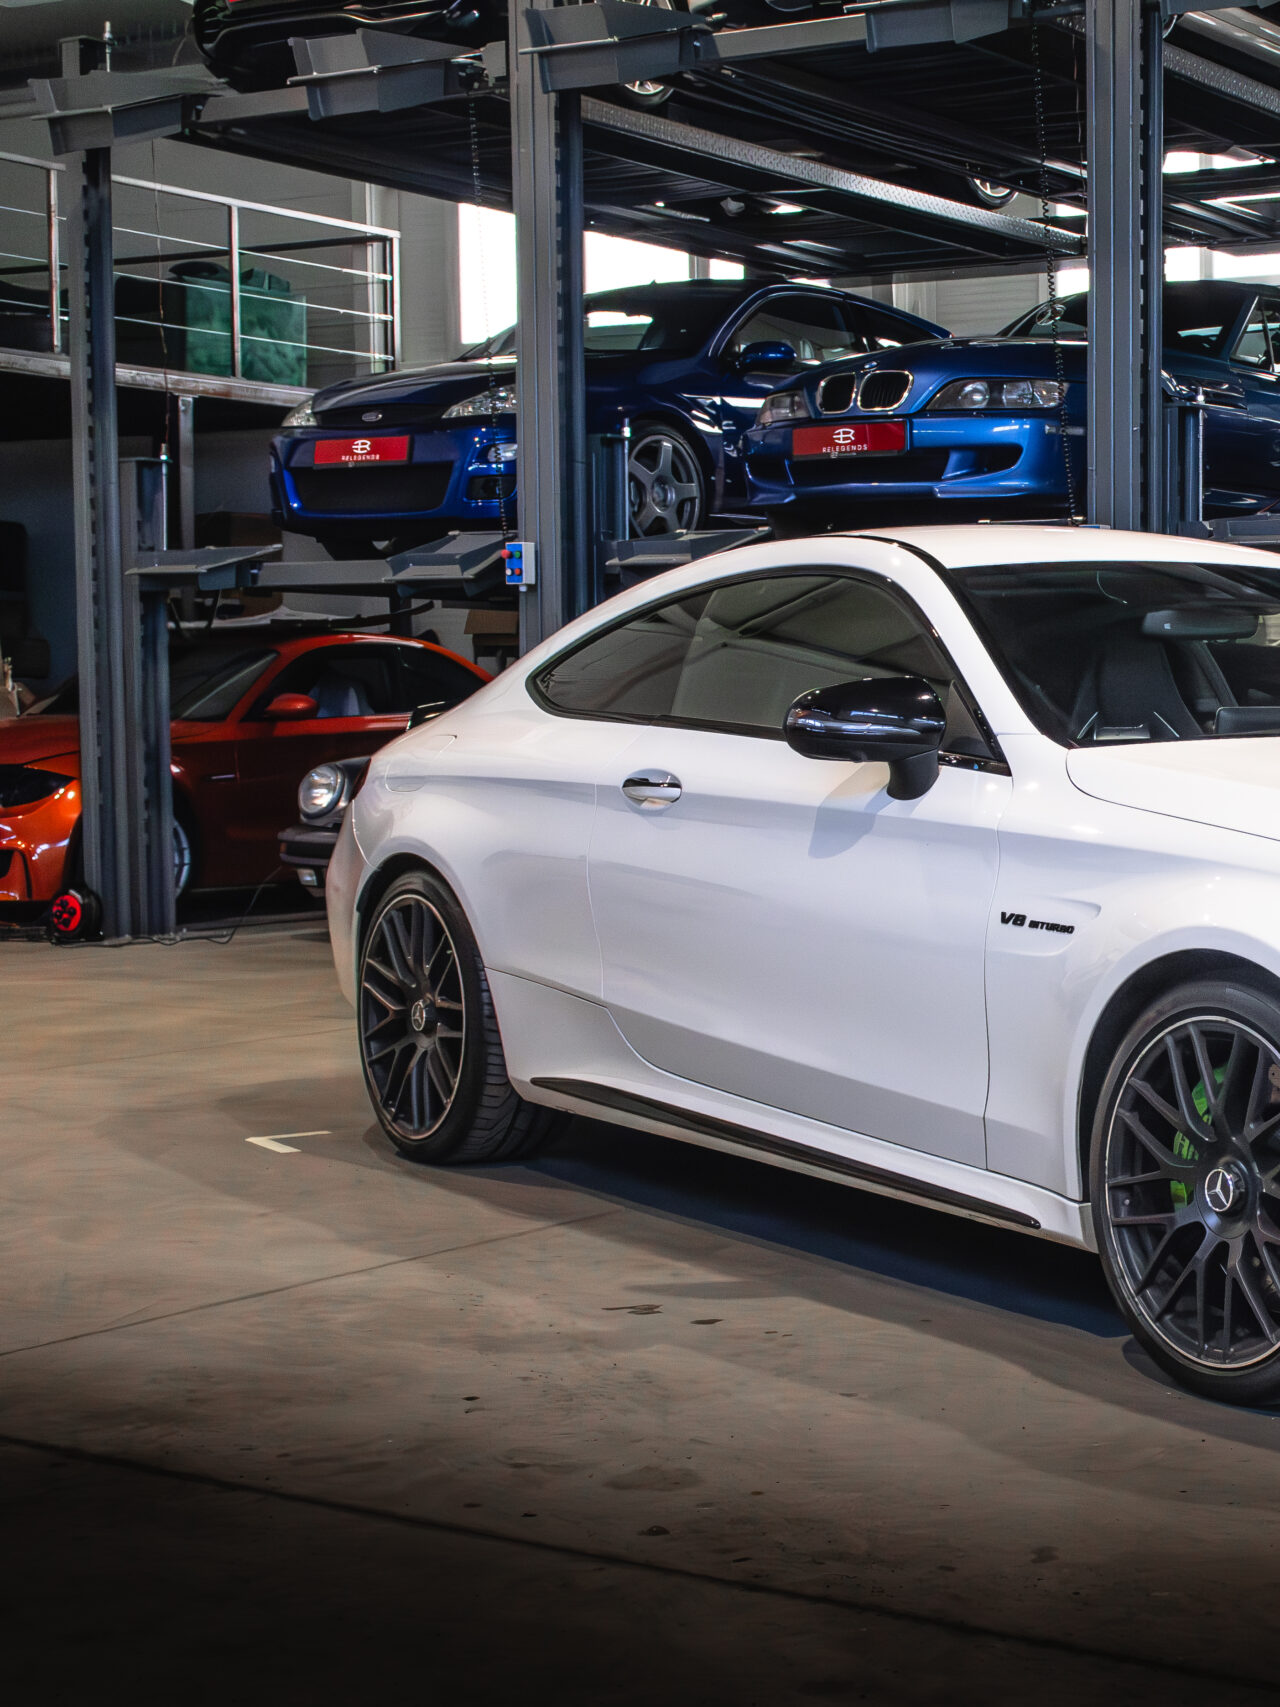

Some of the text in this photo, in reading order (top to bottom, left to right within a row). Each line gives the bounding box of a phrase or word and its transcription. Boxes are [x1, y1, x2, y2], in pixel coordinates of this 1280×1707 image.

[822, 444, 868, 453] RELEGENDS
[1000, 911, 1075, 934] V8 BITURBO
